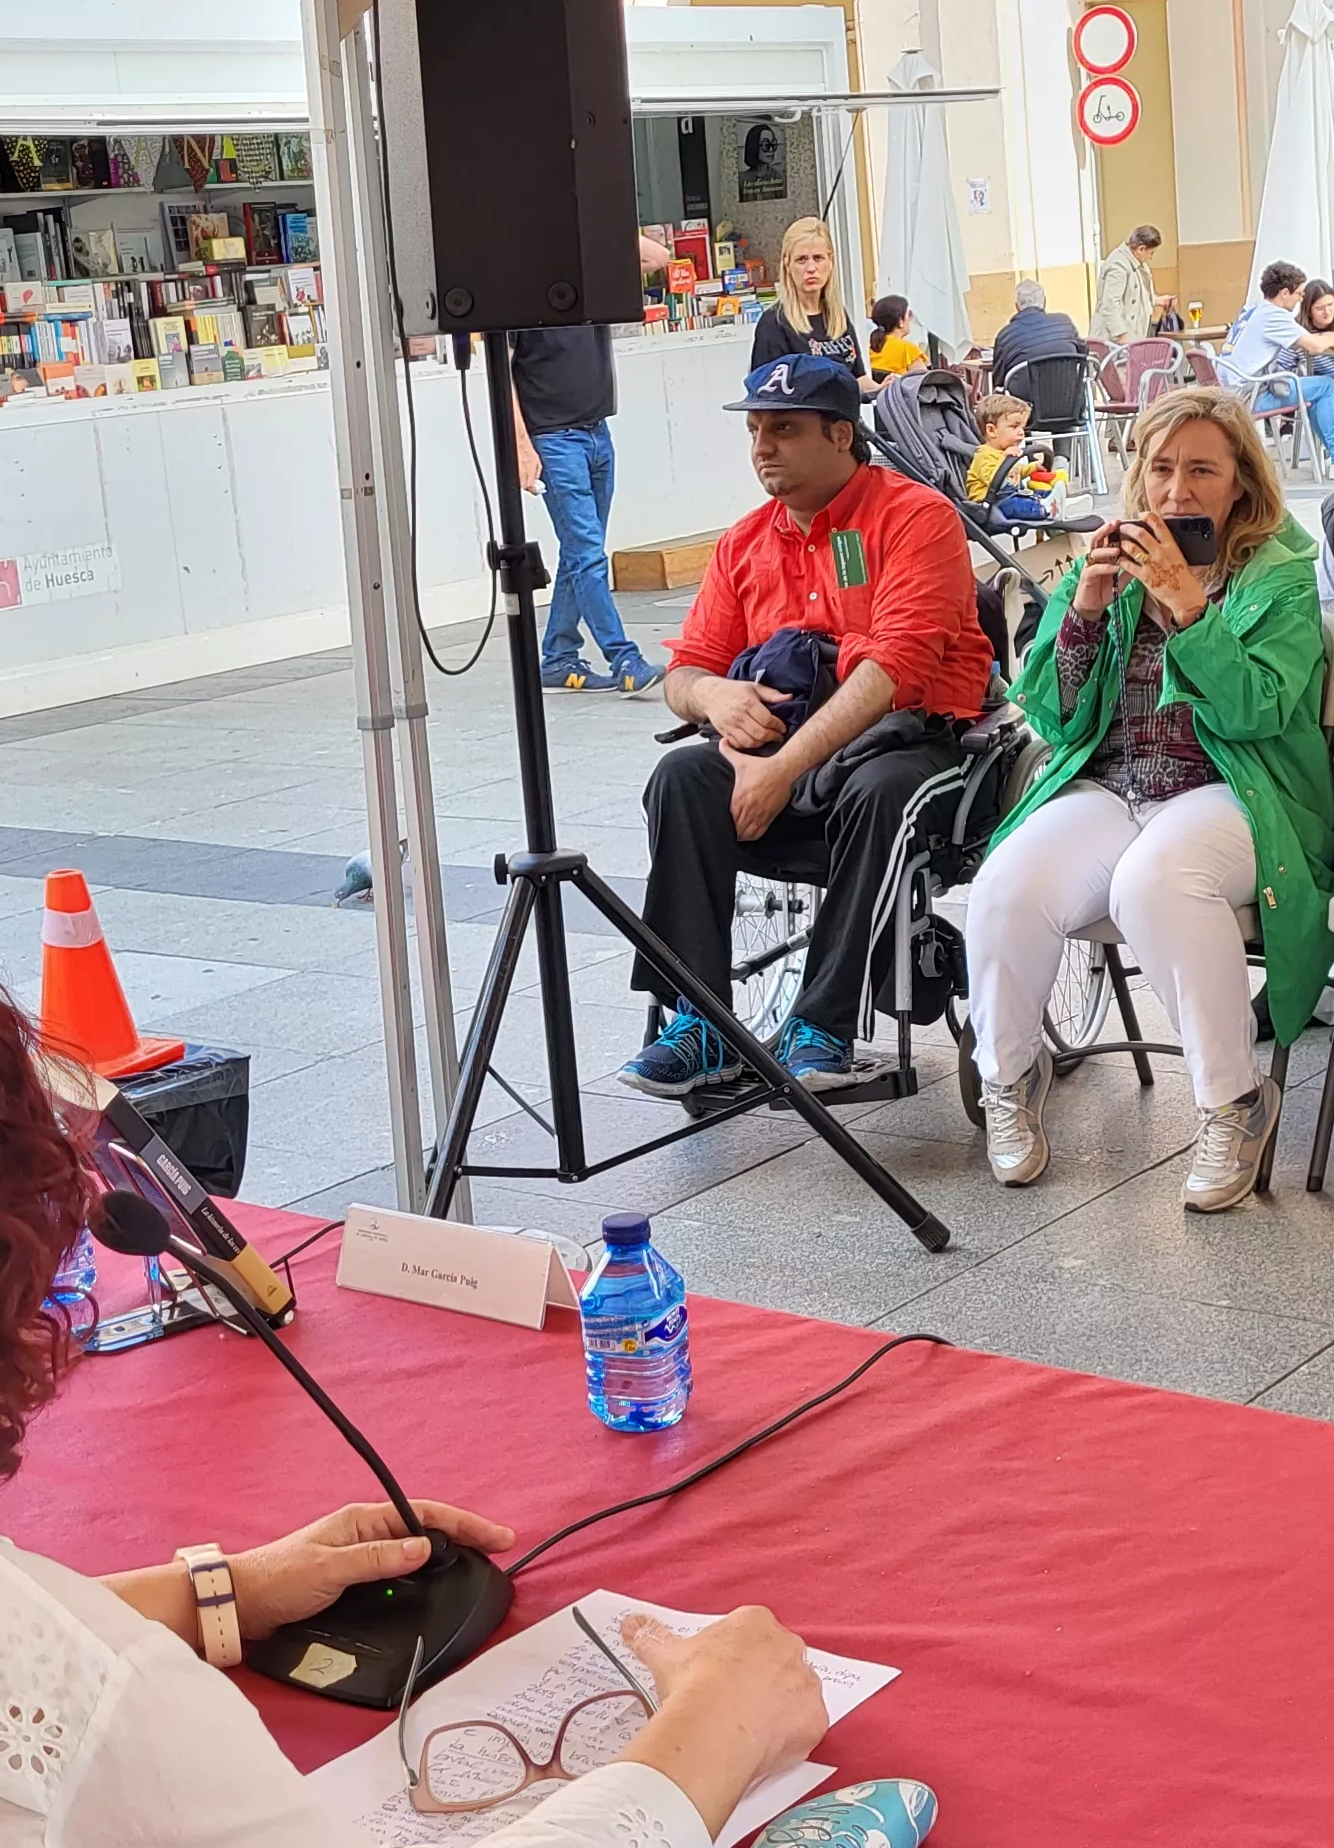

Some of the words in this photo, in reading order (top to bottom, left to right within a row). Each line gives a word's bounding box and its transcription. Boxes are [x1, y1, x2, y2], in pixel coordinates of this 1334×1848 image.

[757, 363, 795, 396] A
[23, 546, 113, 577] Ayuntamiento
[25, 577, 41, 593] de
[45, 568, 95, 589] Huesca
[564, 672, 587, 690] N
[157, 1154, 180, 1182] GARCÍA
[174, 1174, 192, 1196] PUIG
[401, 1262, 410, 1274] D.
[412, 1264, 429, 1277] Mar
[431, 1269, 458, 1283] García
[460, 1274, 478, 1290] Puig
[308, 1657, 334, 1676] 2
